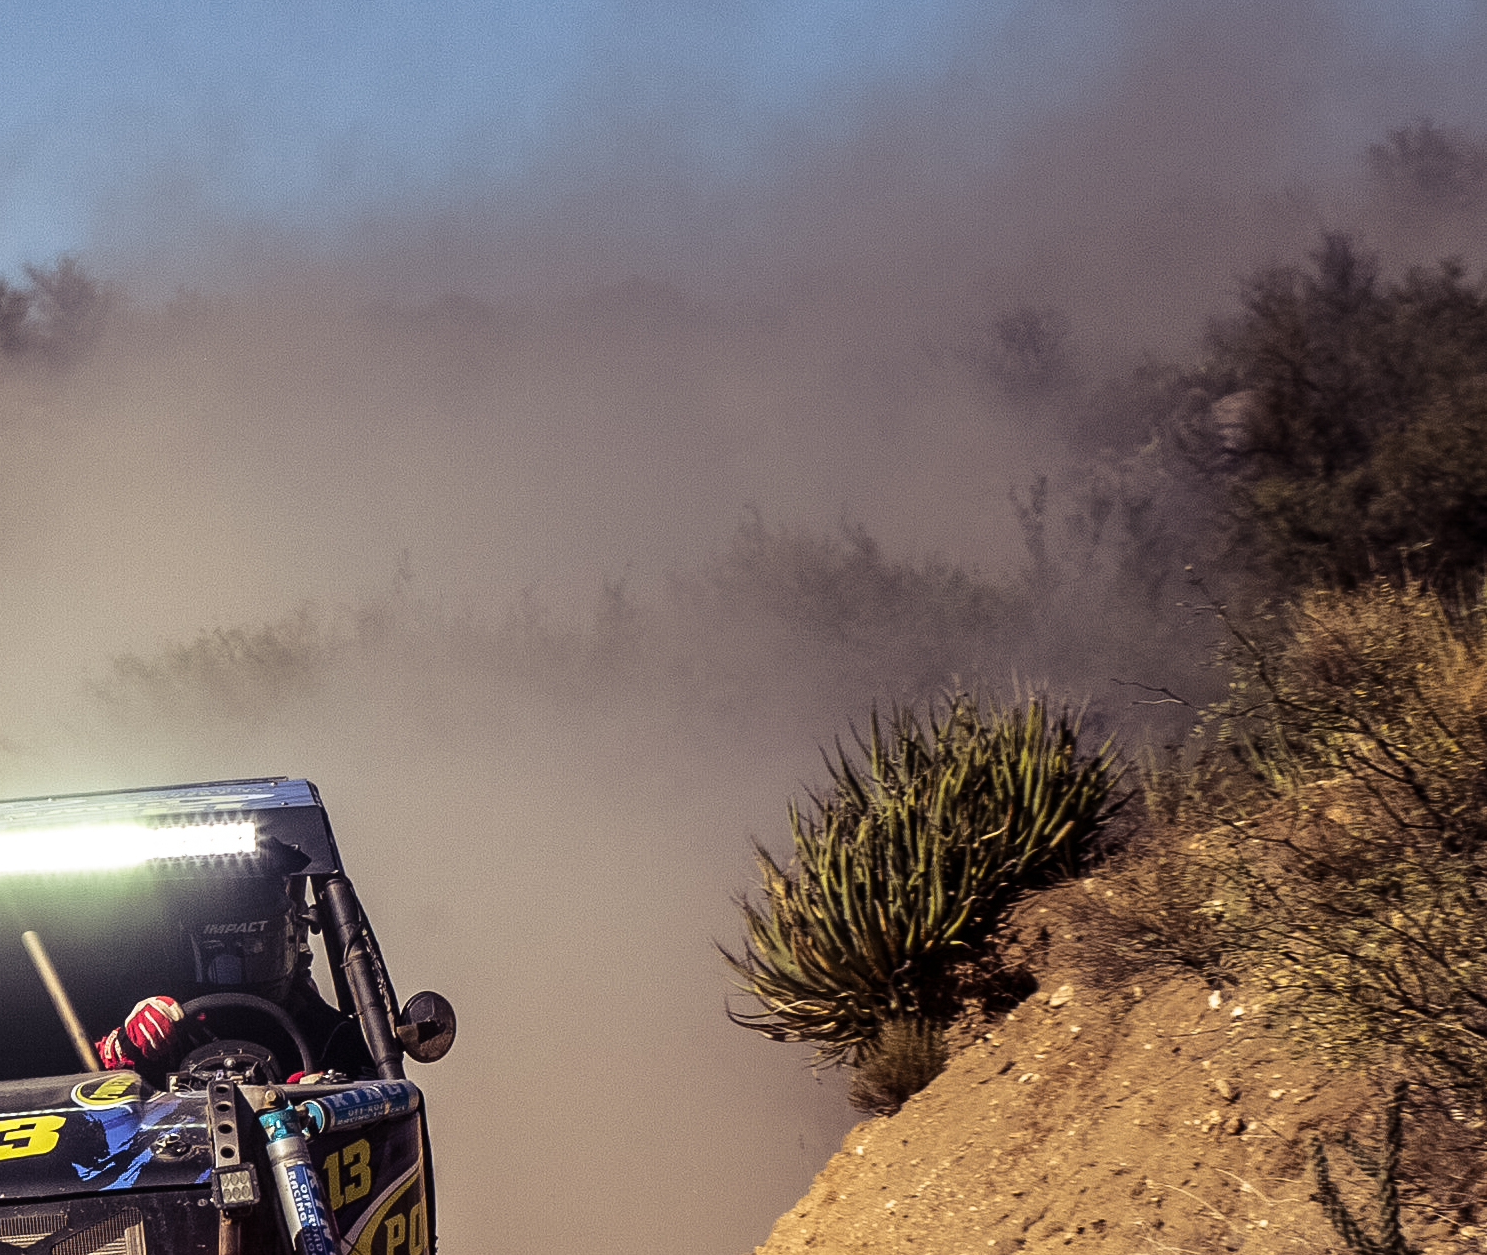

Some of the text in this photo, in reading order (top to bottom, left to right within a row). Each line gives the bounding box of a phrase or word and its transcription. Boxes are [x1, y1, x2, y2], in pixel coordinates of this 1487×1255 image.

[203, 921, 268, 934] IMPACT
[287, 1170, 307, 1222] RACING
[323, 1138, 371, 1211] 13
[300, 1183, 323, 1252] OFF-ROAD
